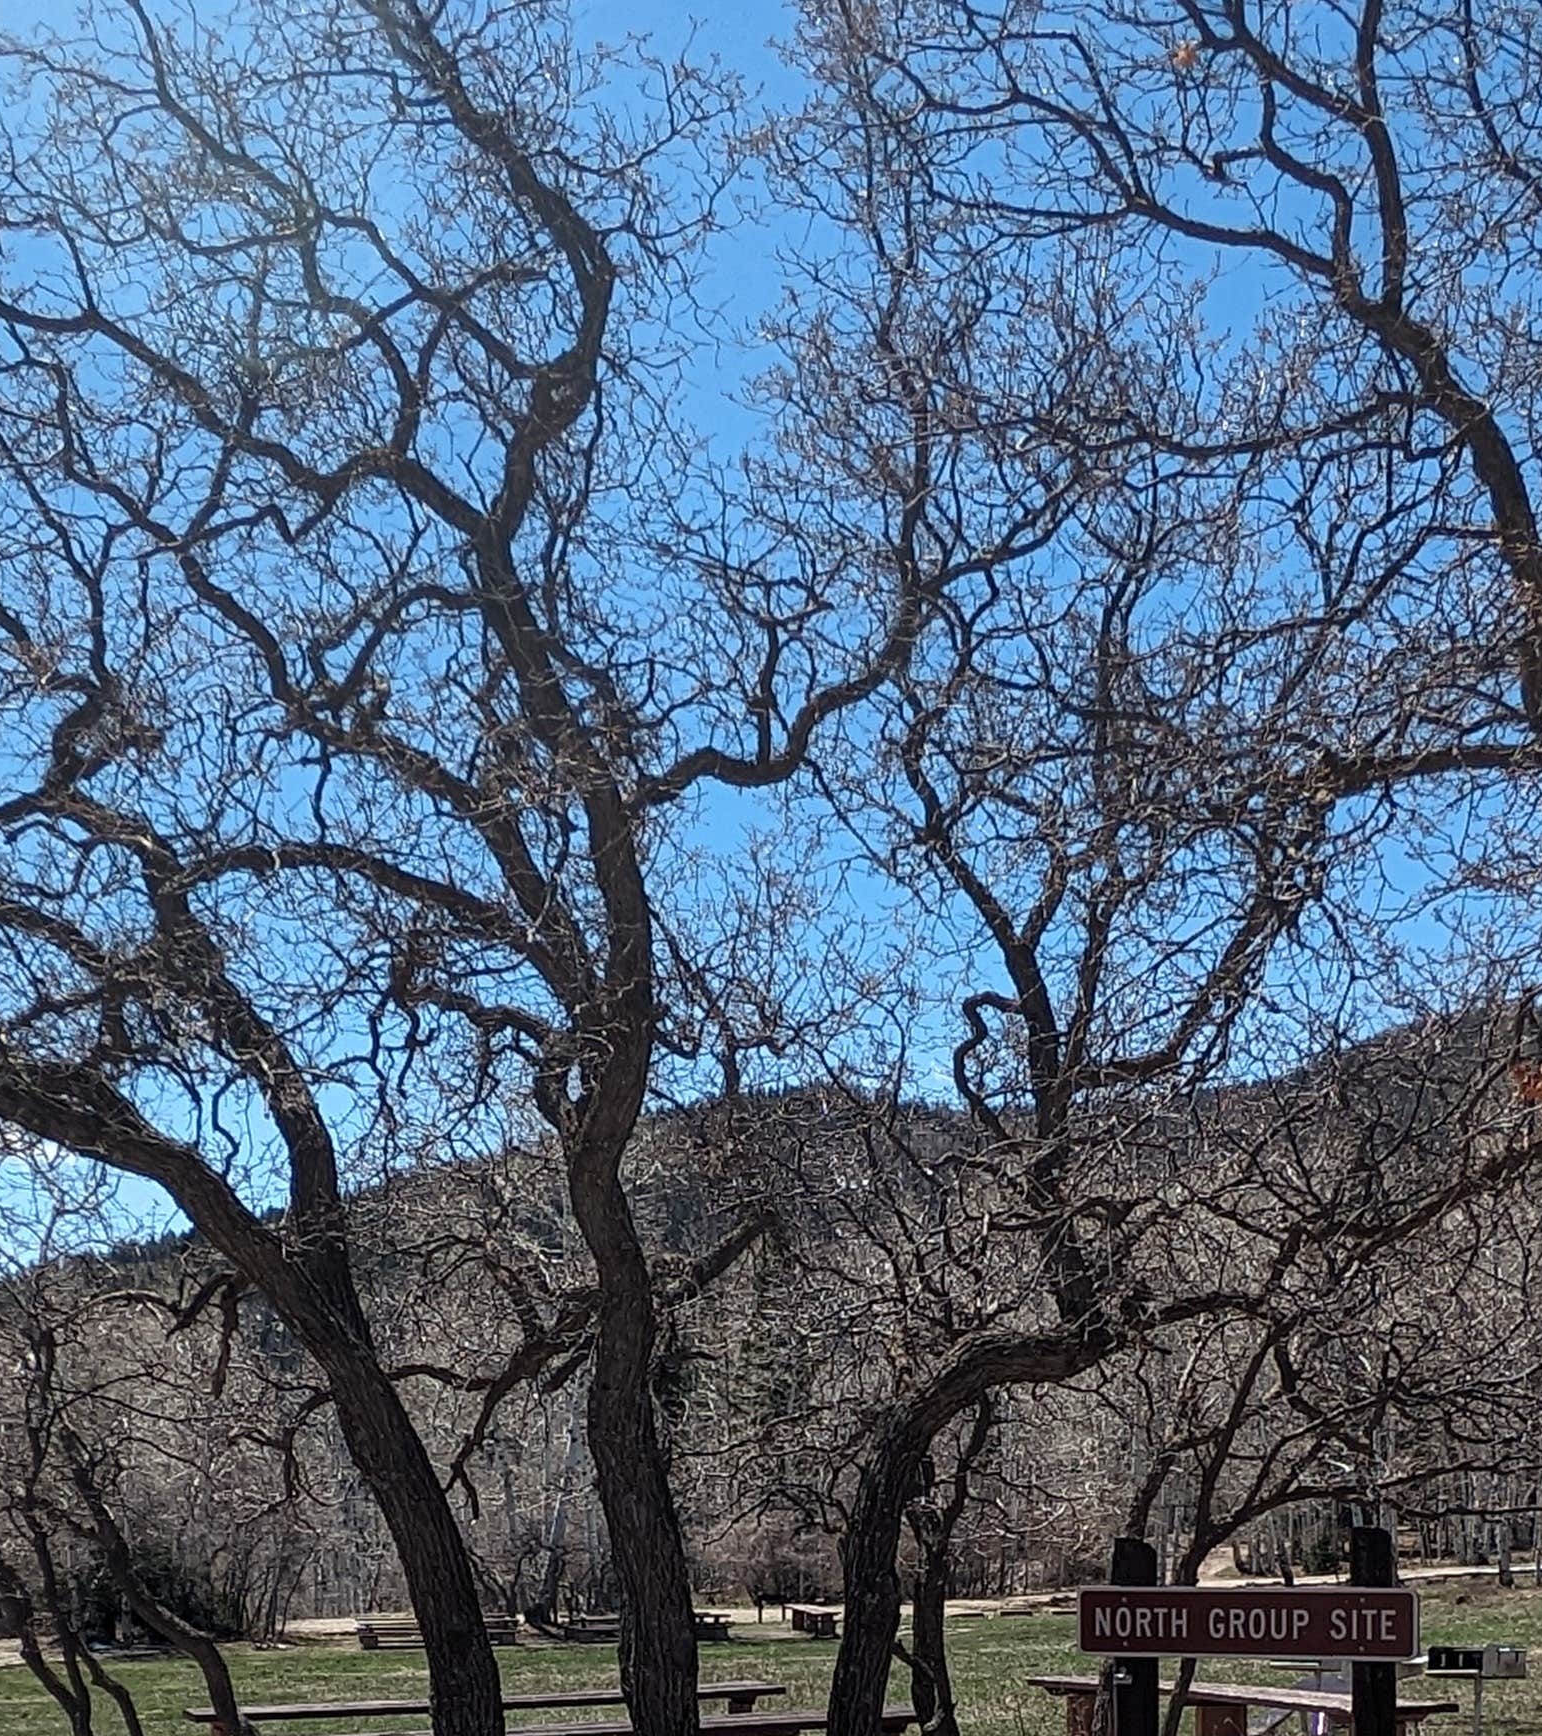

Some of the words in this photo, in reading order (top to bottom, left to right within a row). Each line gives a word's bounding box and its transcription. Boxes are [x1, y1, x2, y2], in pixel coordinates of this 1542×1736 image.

[1094, 1606, 1188, 1639] NORTH
[1209, 1608, 1309, 1640] GROUP
[1330, 1608, 1397, 1641] SITE
